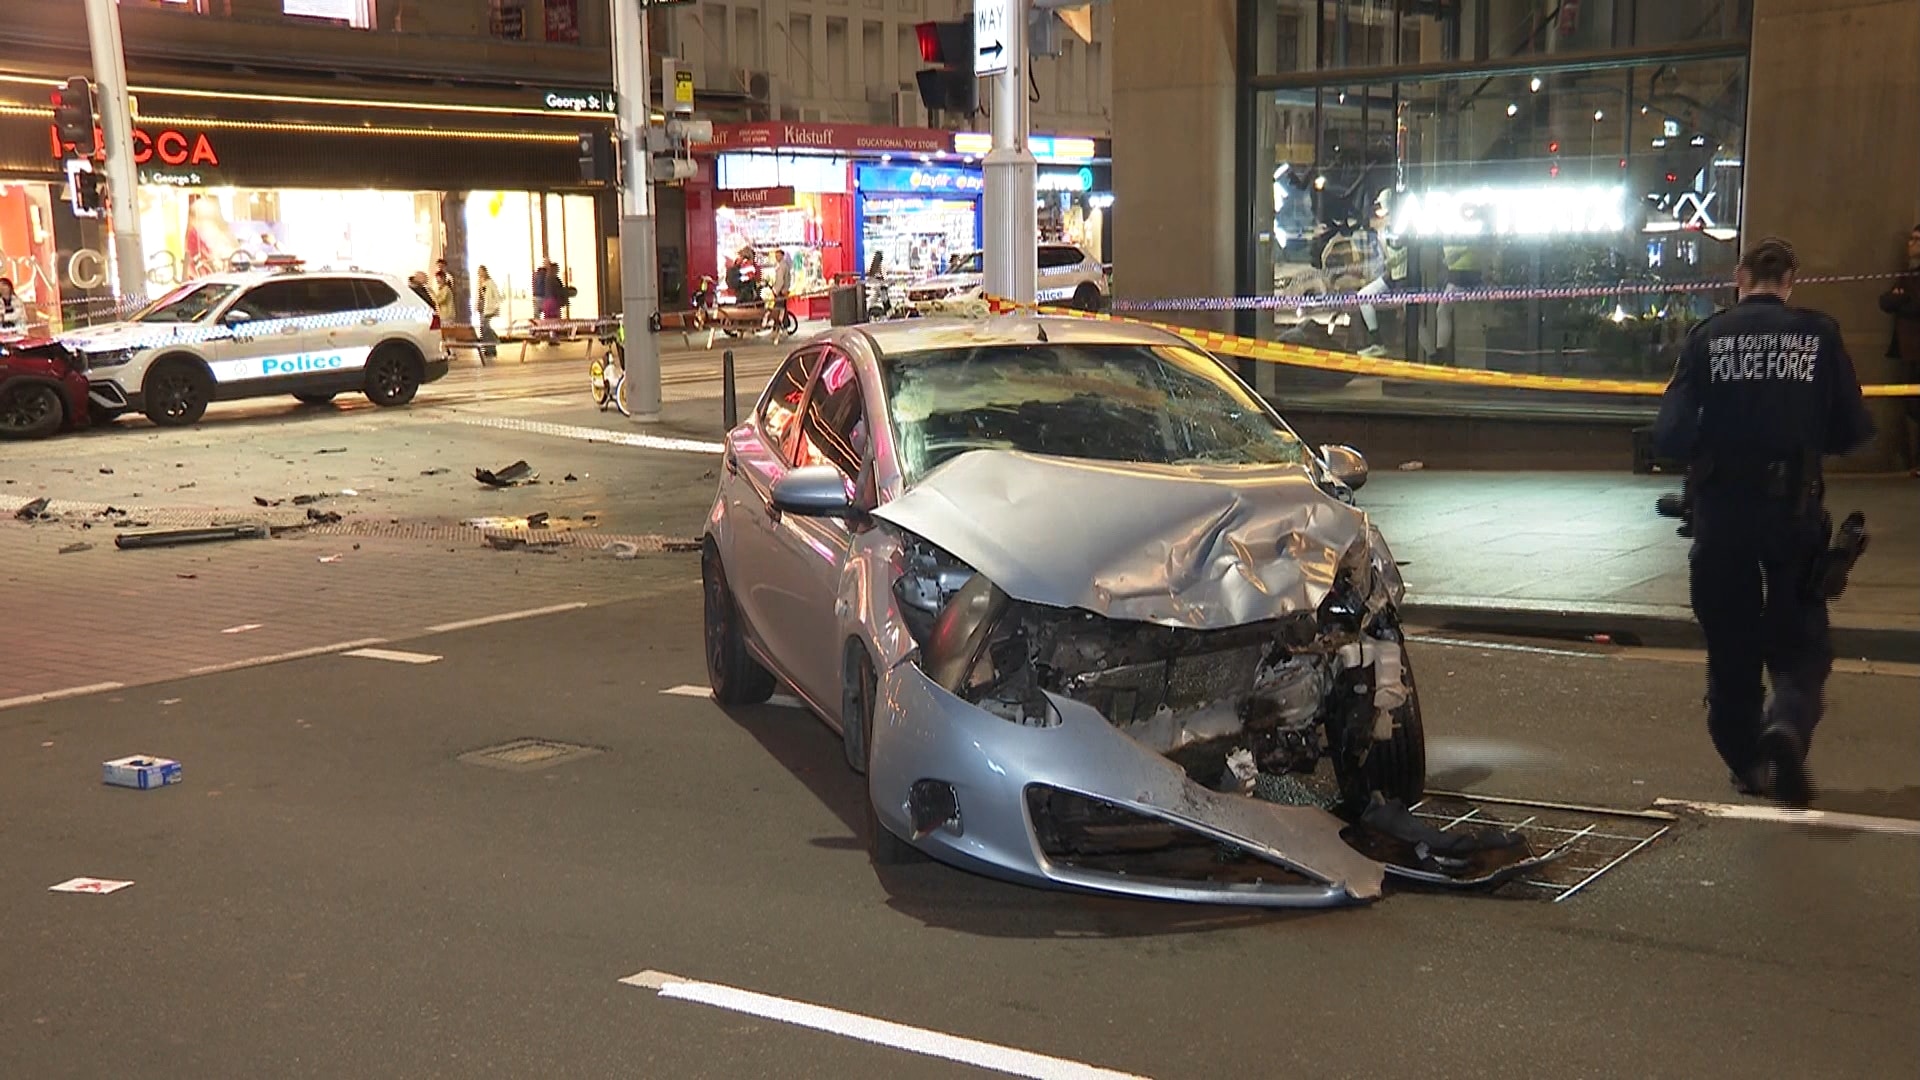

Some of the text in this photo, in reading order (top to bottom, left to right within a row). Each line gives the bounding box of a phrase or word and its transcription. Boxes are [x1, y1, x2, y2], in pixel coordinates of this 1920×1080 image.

[978, 4, 1004, 34] WAY
[546, 94, 600, 111] George St
[784, 125, 834, 145] Kidstuff
[857, 137, 938, 149] EDUCATIONAL TOY STORE
[152, 172, 201, 184] George St
[732, 189, 768, 202] Kidstuff
[1037, 286, 1063, 300] olice
[1709, 333, 1819, 355] NEW SOUTH WALES
[262, 354, 342, 375] Police
[1710, 352, 1817, 383] POLICE FORCE
